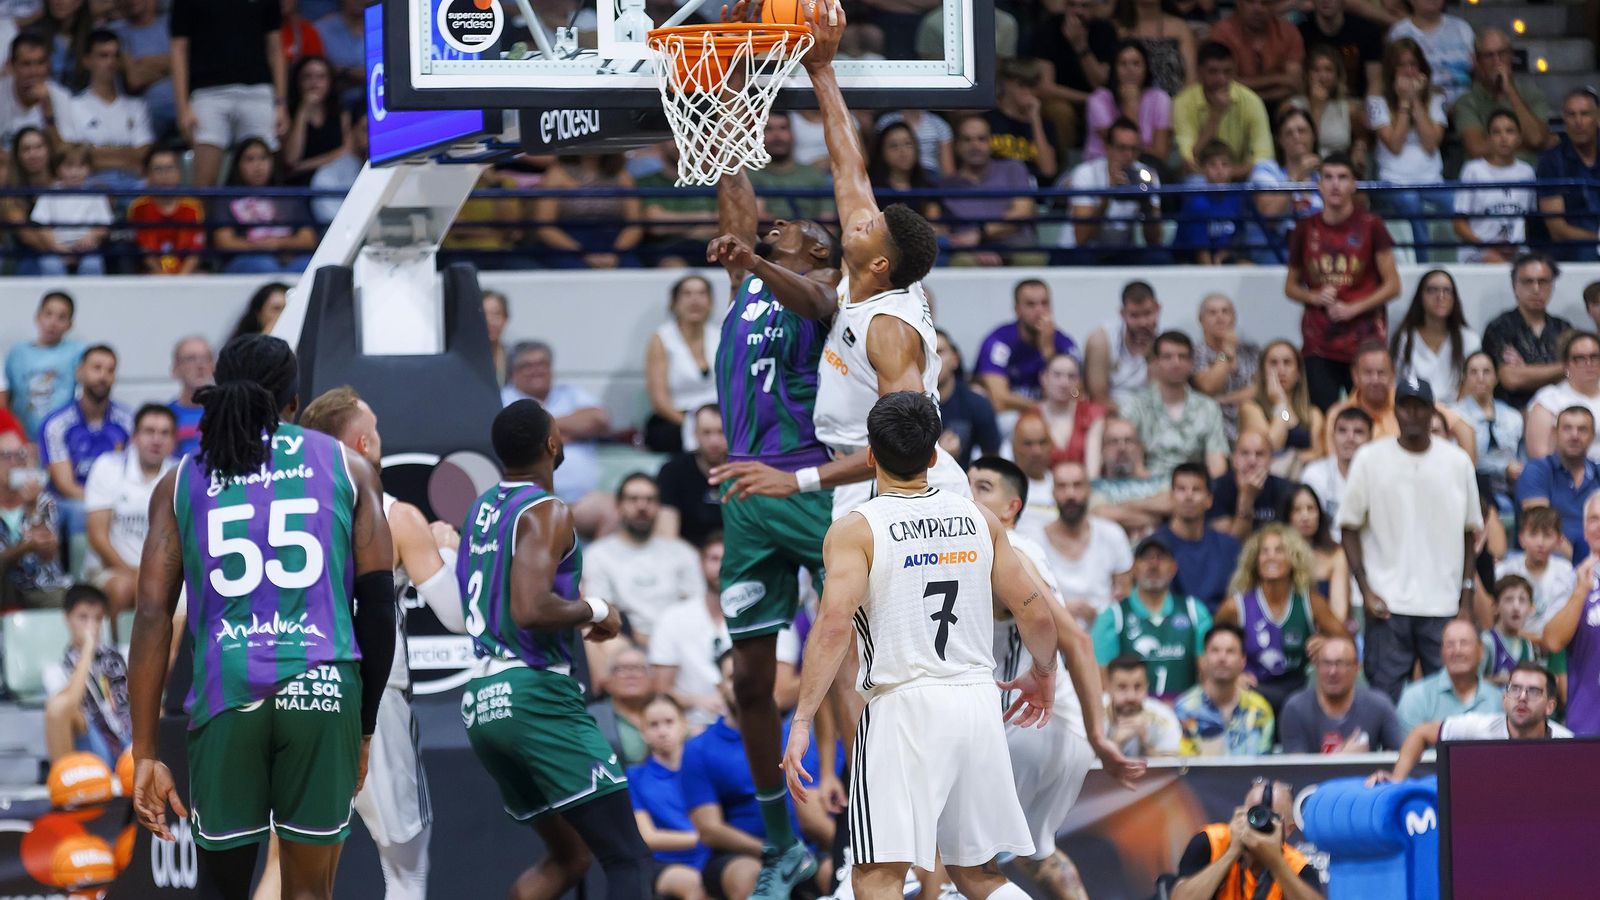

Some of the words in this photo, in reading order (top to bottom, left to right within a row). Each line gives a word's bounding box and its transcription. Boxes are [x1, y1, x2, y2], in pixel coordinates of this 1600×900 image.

[447, 12, 493, 20] supercopa
[452, 19, 494, 29] endesa
[888, 516, 977, 542] CAMPAZZO
[207, 497, 324, 598] 55
[903, 550, 978, 569] AUTOHERO
[465, 569, 487, 638] 3
[215, 609, 328, 643] Andalucía
[923, 579, 959, 662] 7
[311, 681, 344, 699] SOL
[274, 695, 341, 713] MÁLAGA
[489, 694, 513, 709] SOL
